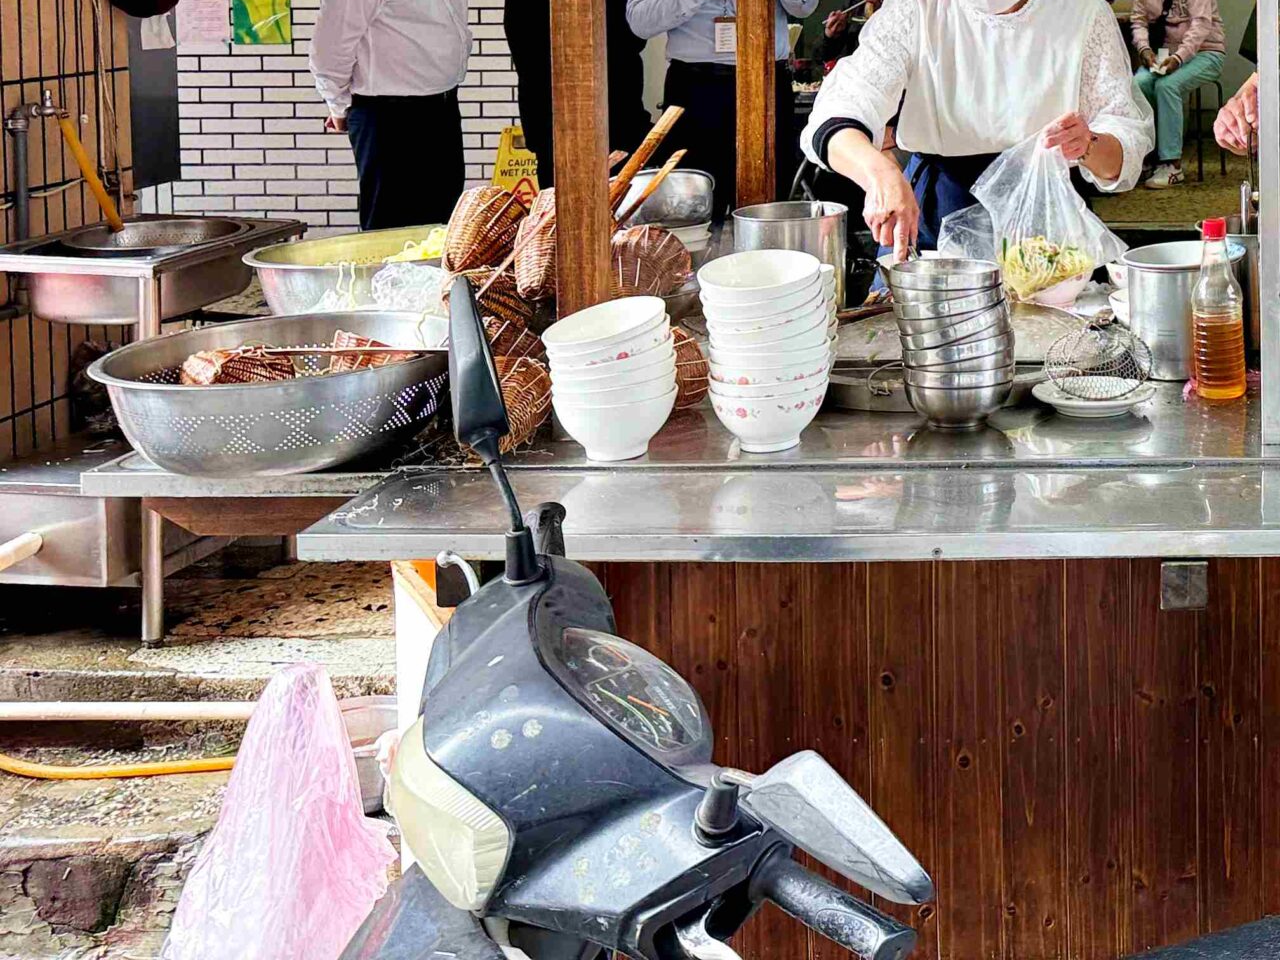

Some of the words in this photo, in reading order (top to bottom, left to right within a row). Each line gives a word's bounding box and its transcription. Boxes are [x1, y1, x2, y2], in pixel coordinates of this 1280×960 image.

[508, 159, 538, 167] CAUTIO
[500, 169, 519, 177] WET
[521, 168, 538, 176] FLO
